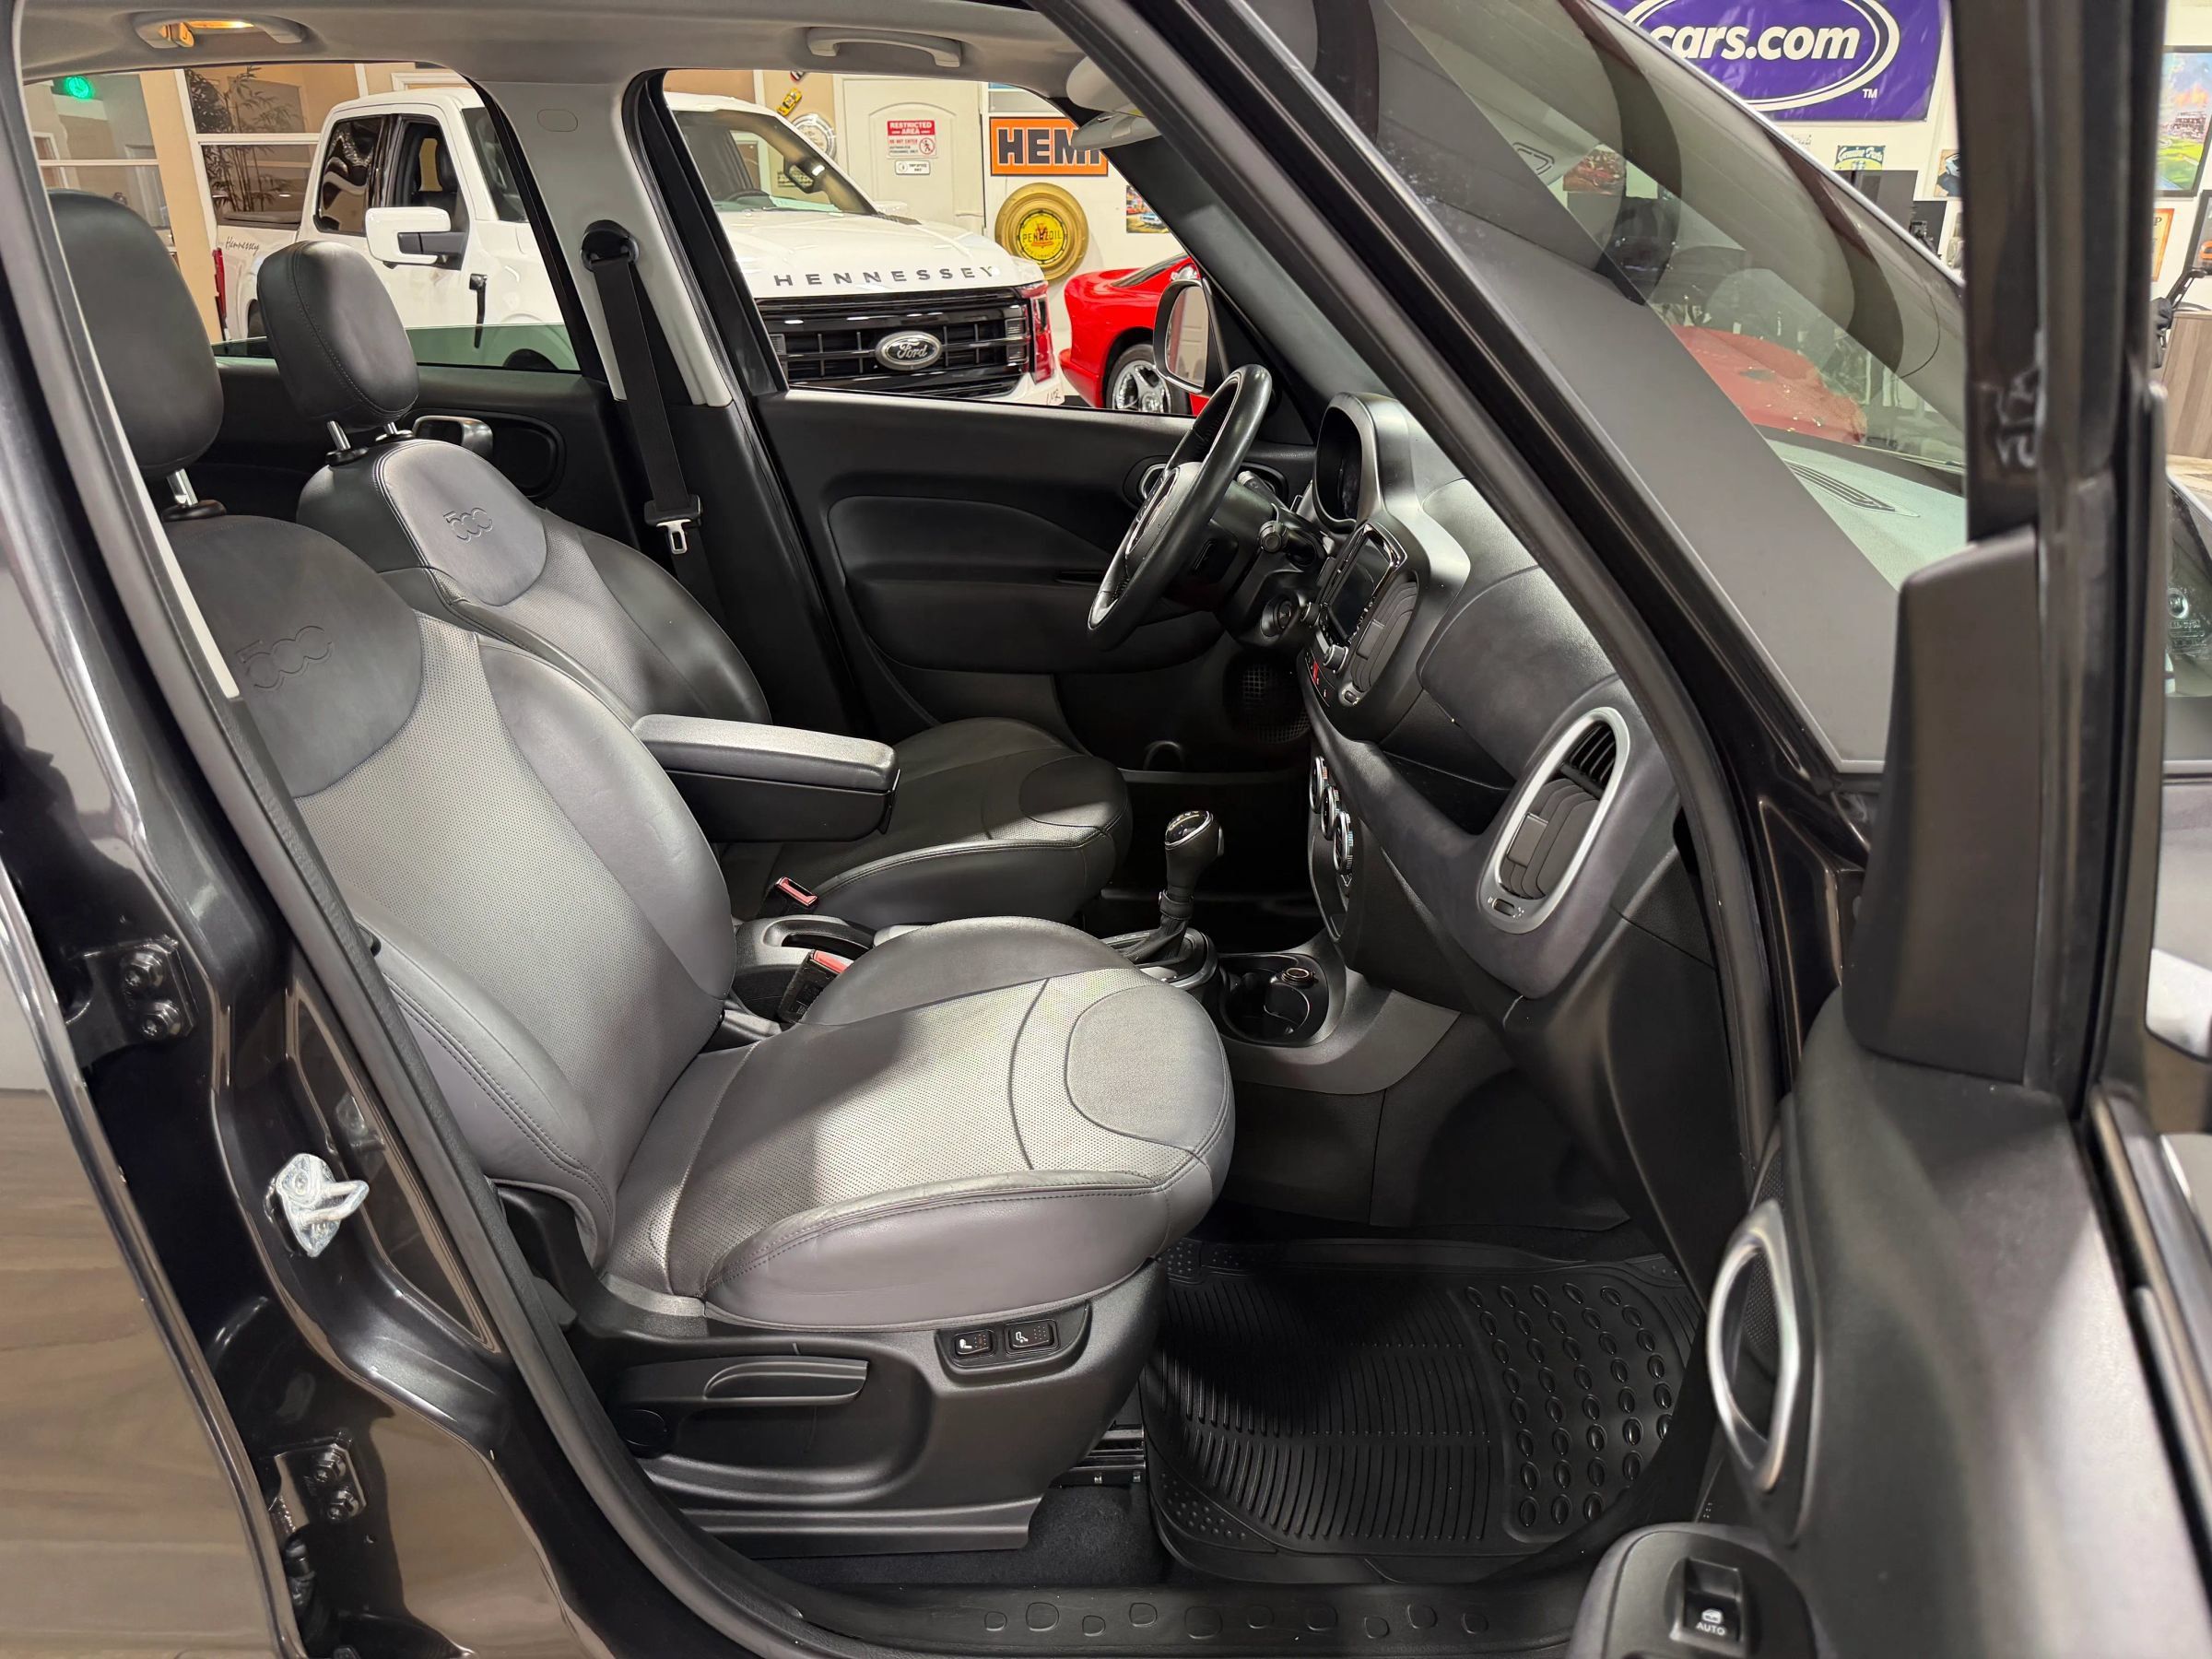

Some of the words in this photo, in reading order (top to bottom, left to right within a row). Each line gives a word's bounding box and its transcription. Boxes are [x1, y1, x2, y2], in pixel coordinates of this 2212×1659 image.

[1863, 88, 1878, 99] TM
[773, 265, 994, 287] HENNESSEY
[897, 339, 928, 359] Ford
[442, 508, 493, 544] 500
[235, 624, 335, 691] 500
[1695, 1622, 1727, 1637] AUTO
